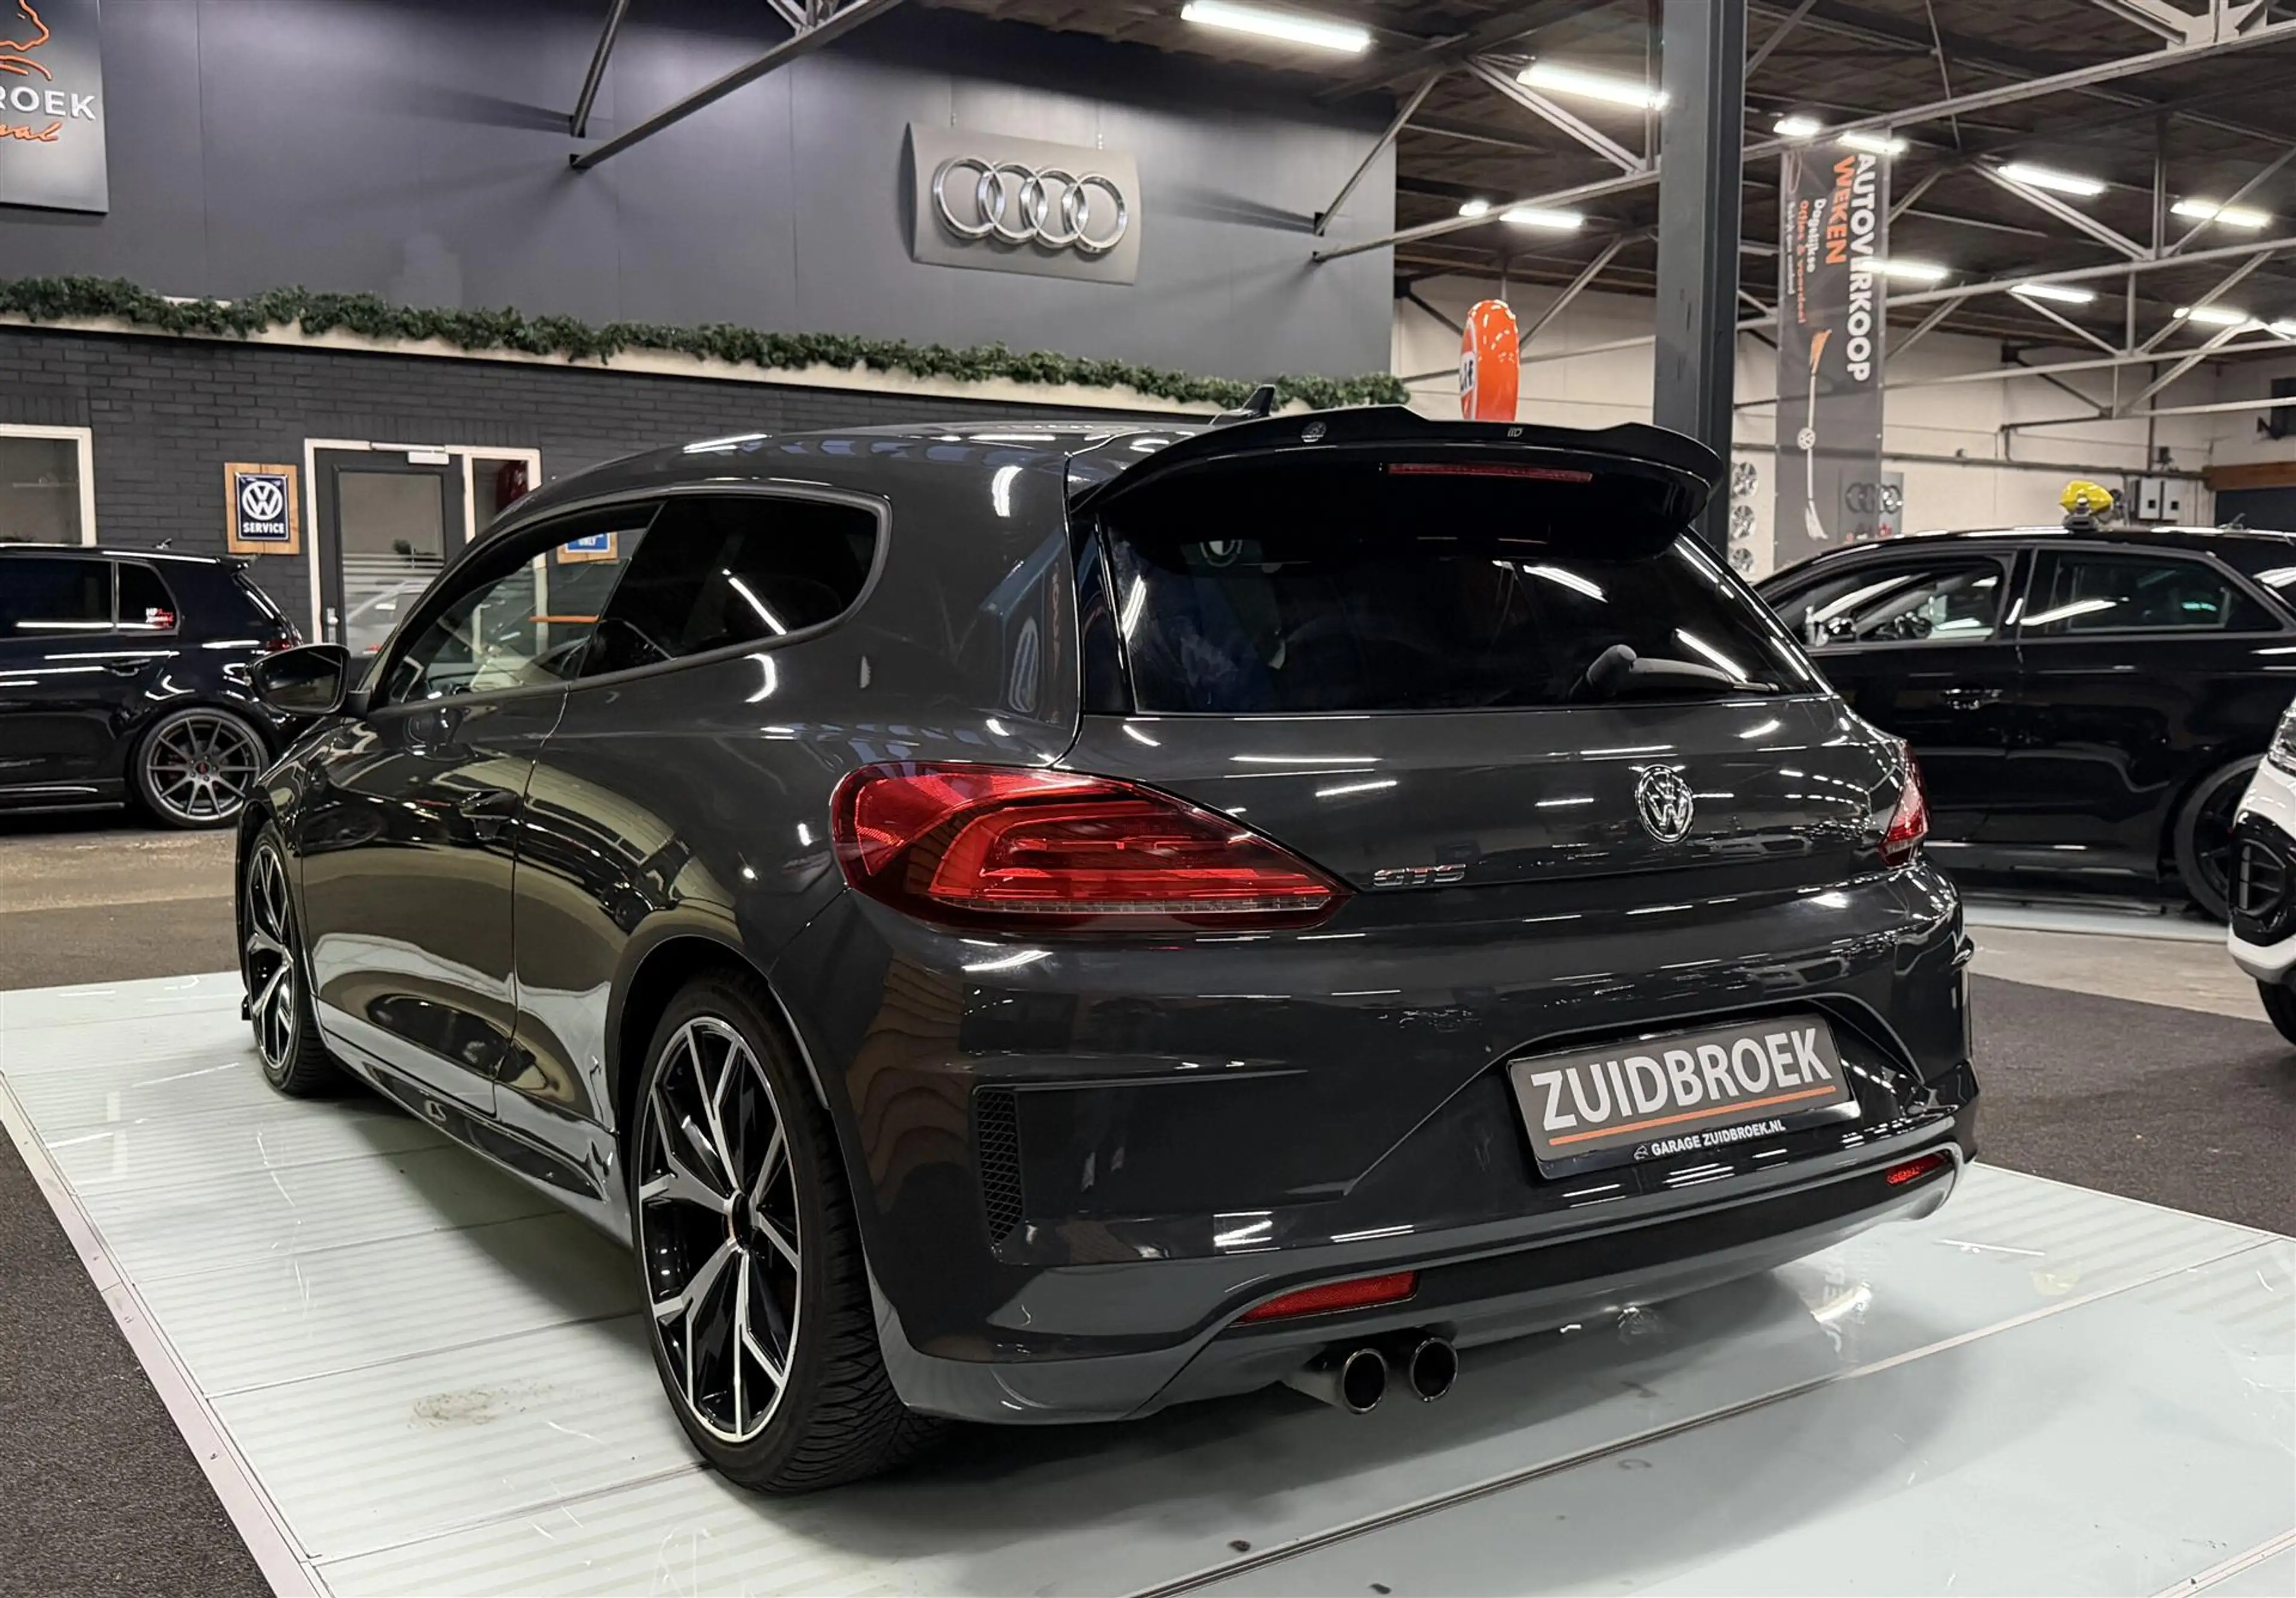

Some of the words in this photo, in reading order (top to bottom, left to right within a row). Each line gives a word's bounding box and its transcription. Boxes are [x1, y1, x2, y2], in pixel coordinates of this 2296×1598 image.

[1825, 155, 1856, 264] WEKEN
[243, 522, 285, 534] SERVICE
[1374, 864, 1465, 886] GTS
[1531, 1027, 1831, 1132] ZUIDBROEK
[1651, 1135, 1702, 1156] GARAGE
[1702, 1119, 1787, 1146] ZUIDBROEK.NL
